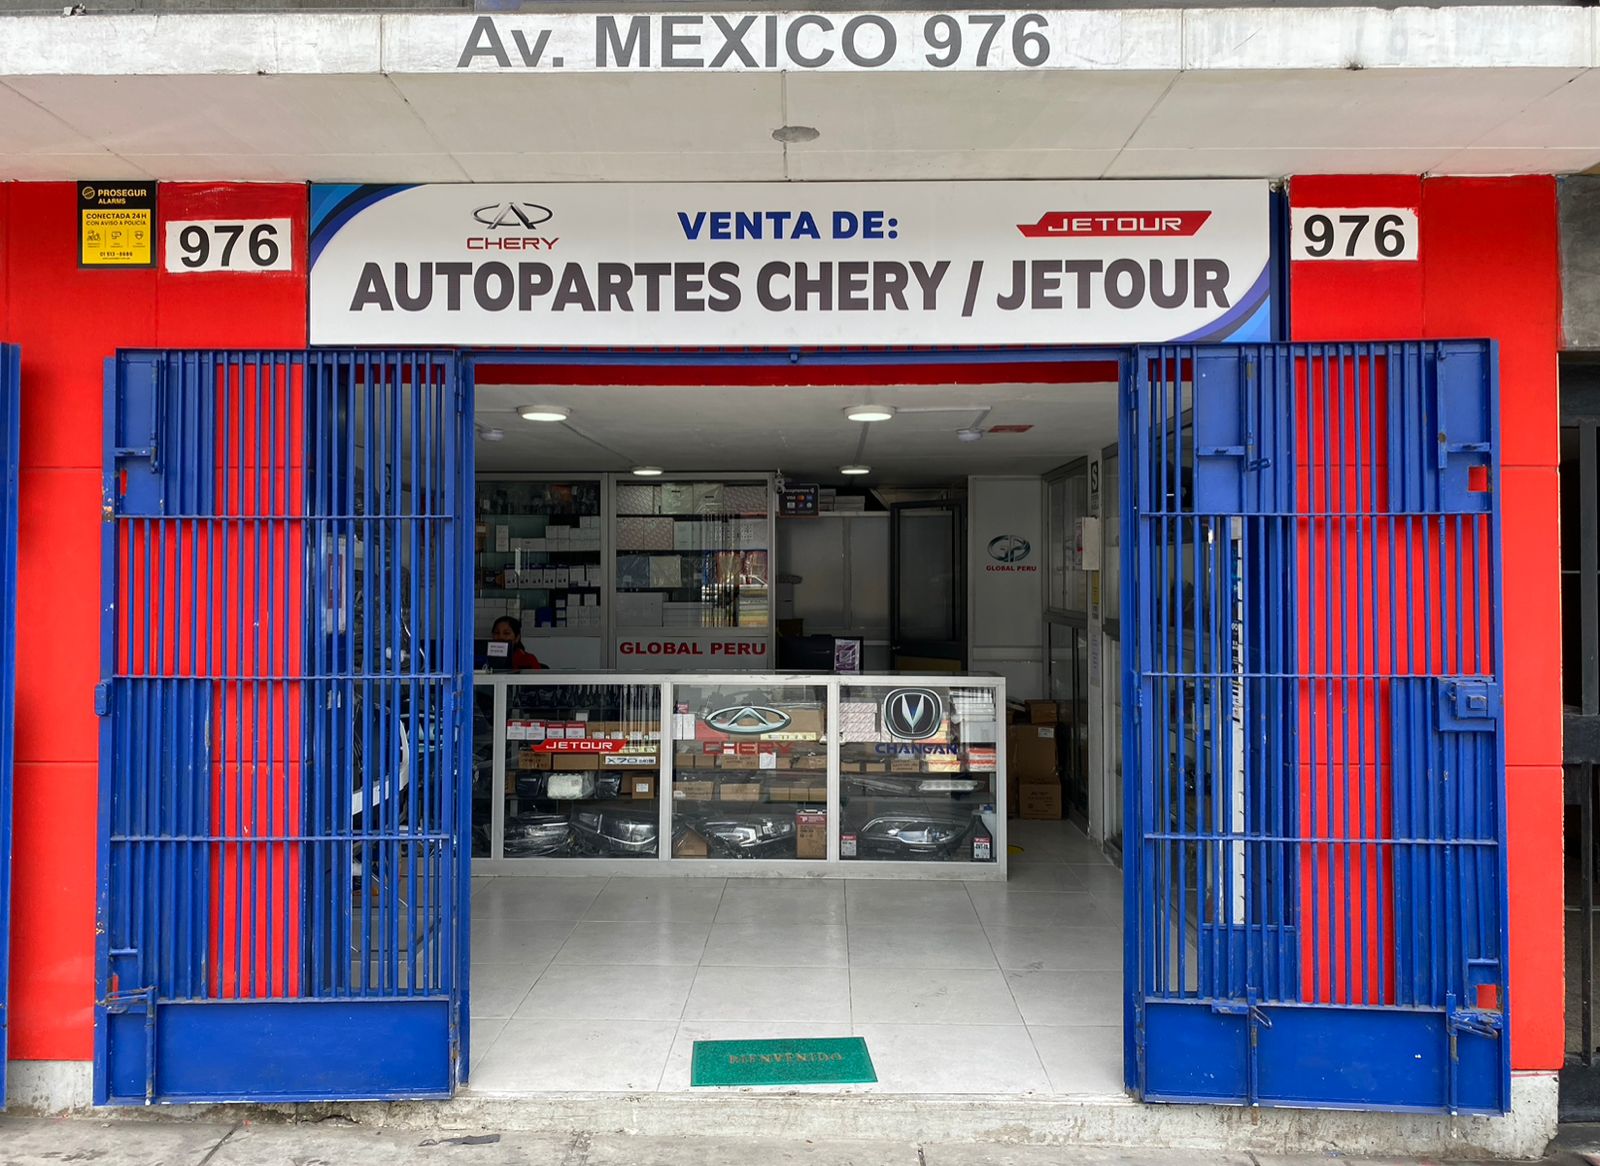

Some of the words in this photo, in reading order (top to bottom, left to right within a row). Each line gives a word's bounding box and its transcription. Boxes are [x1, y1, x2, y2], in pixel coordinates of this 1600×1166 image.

[457, 15, 564, 68] Av.
[596, 14, 898, 68] MEXICO
[923, 13, 1051, 68] 976
[97, 189, 147, 197] PROSEGUR
[677, 210, 822, 240] VENTA
[832, 210, 899, 240] DE:
[1048, 217, 1182, 232] JETOUR
[1304, 214, 1405, 257] 976
[179, 224, 279, 267] 976
[466, 237, 560, 250] CHERY
[349, 261, 741, 312] AUTOPARTES
[757, 260, 952, 312] CHERY
[961, 261, 984, 317] /
[997, 258, 1231, 310] JETOUR
[619, 642, 703, 655] GLOBAL
[710, 642, 766, 655] PERU
[546, 741, 613, 750] JETOUR
[703, 741, 796, 756] CHERY
[875, 742, 958, 755] CHANGAN
[729, 1052, 843, 1065] BIENVENIDO
